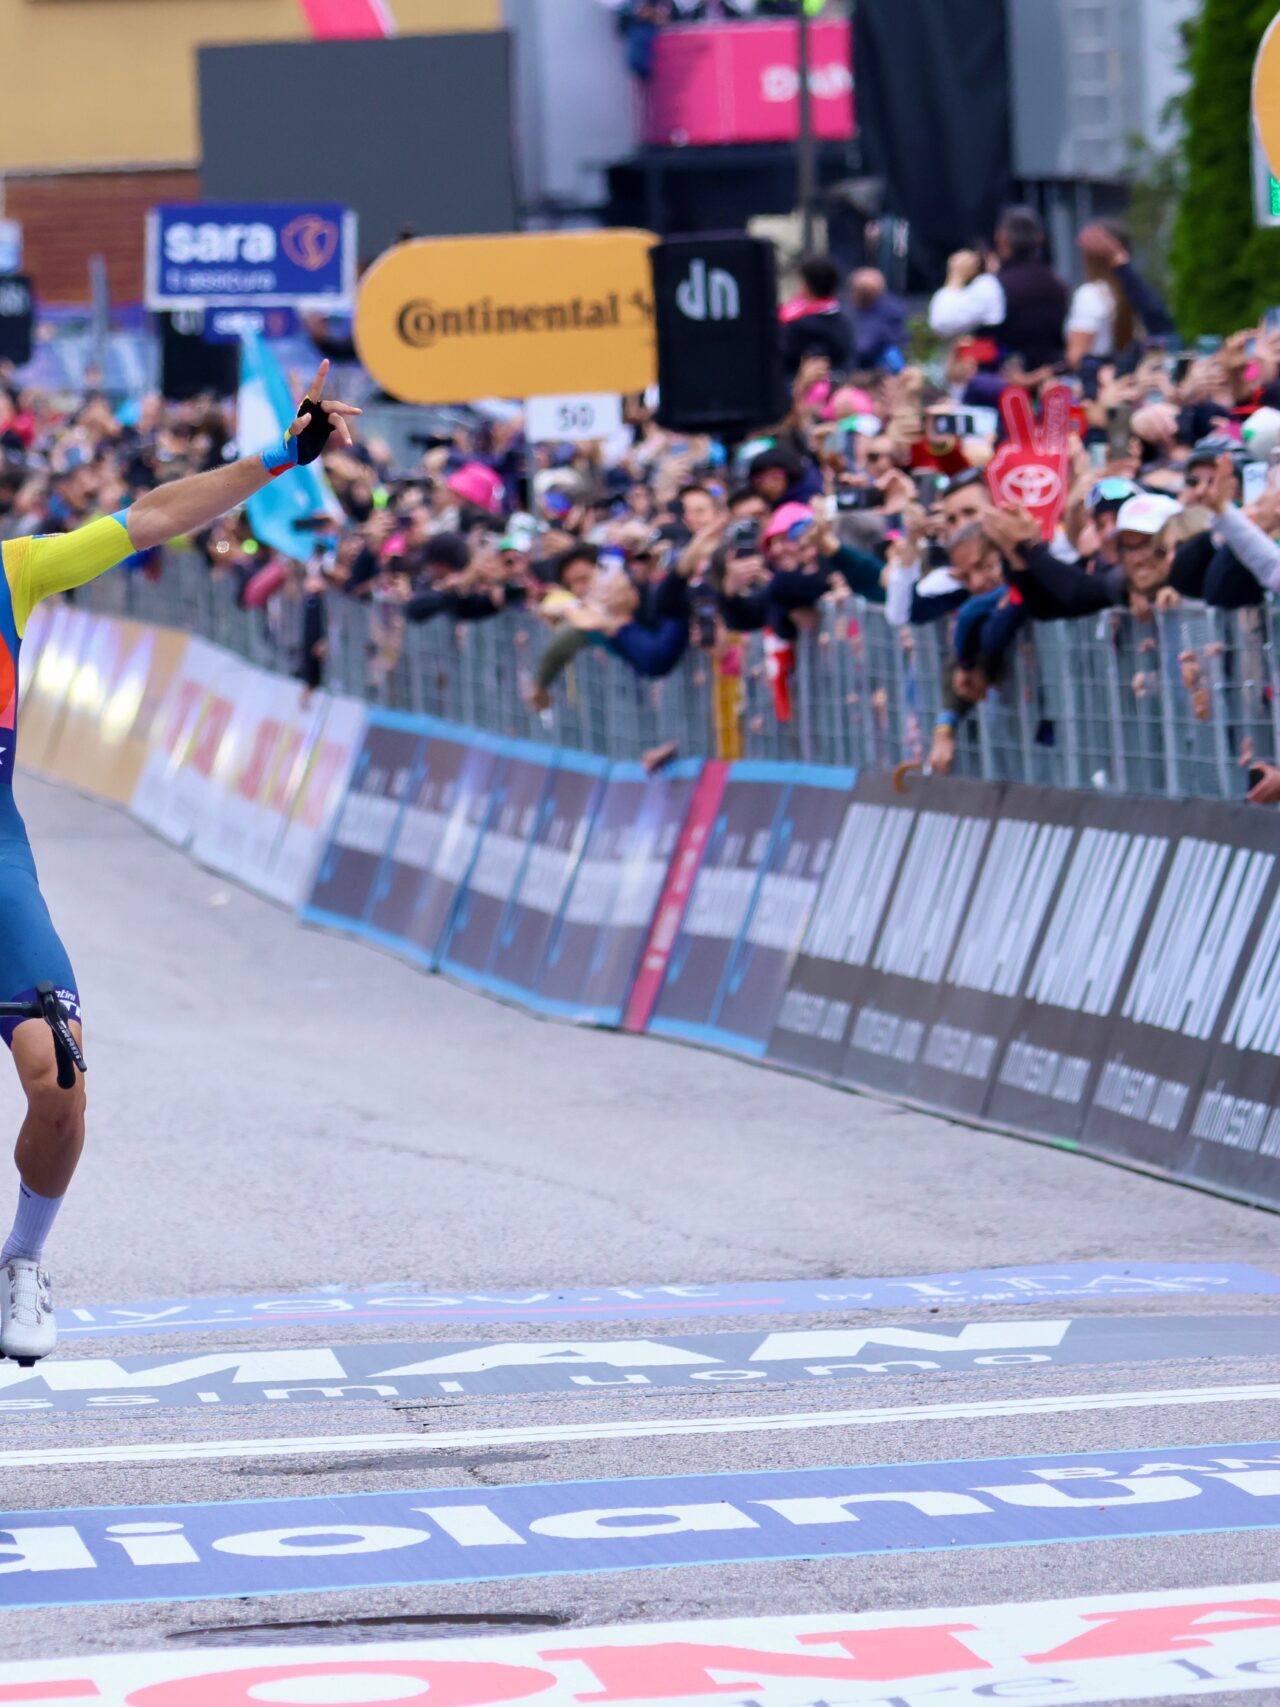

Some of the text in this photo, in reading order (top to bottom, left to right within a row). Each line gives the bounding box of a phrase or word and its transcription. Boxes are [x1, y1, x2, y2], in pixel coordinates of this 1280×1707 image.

[164, 222, 277, 263] sara
[395, 291, 620, 349] Continental
[569, 1352, 1053, 1387] uomo
